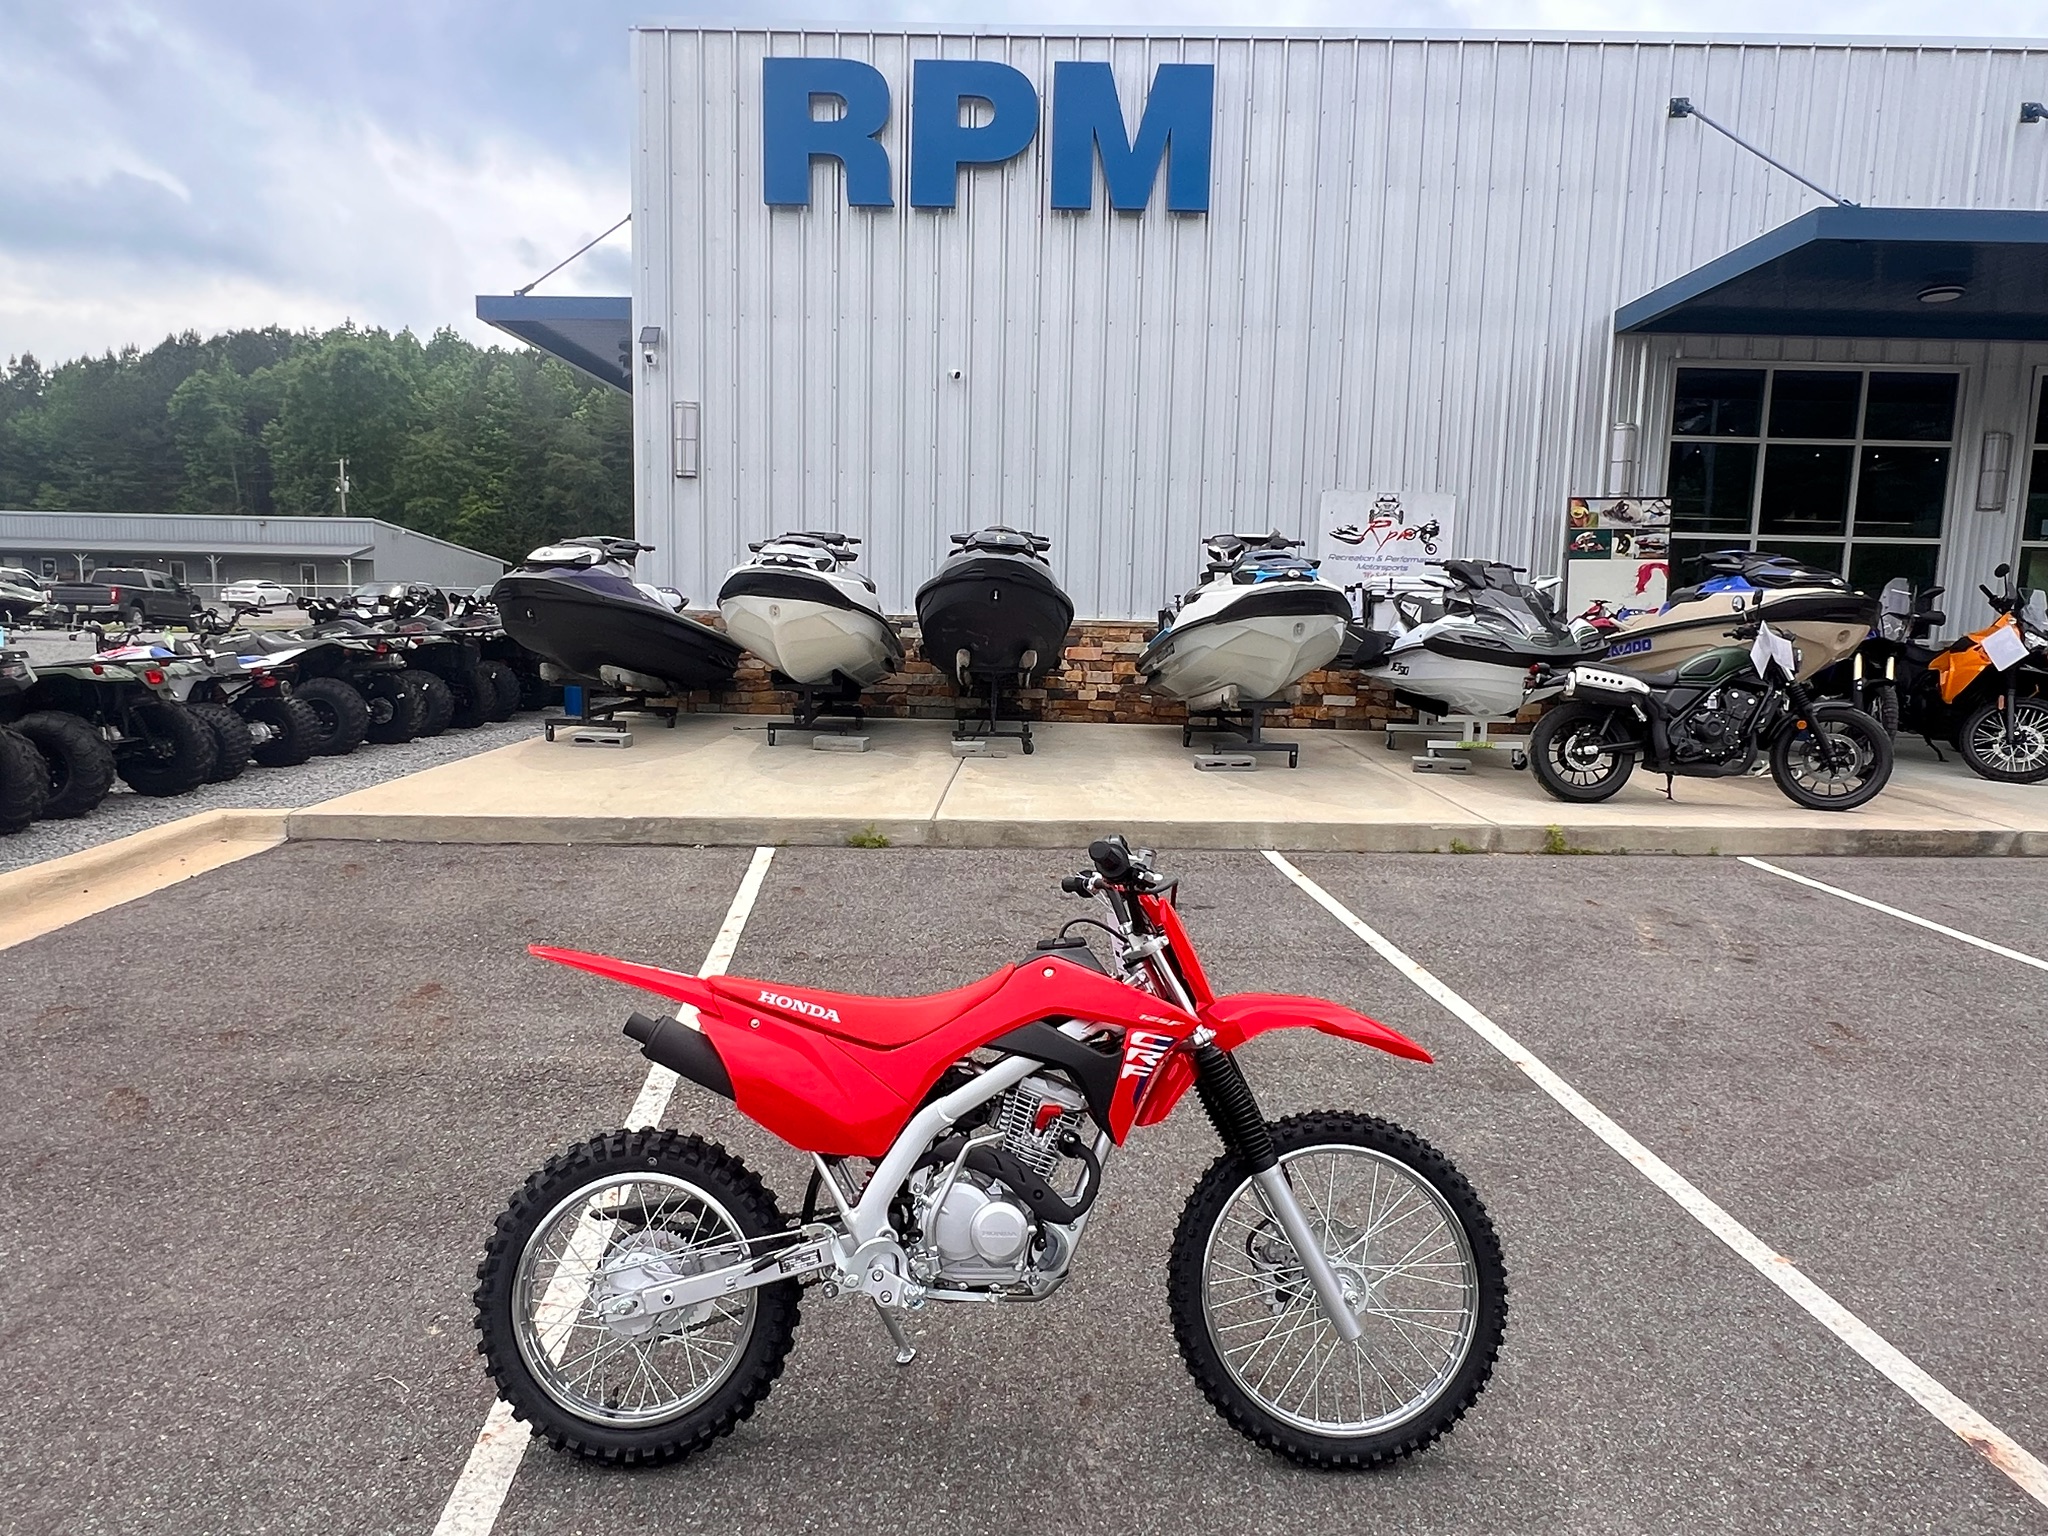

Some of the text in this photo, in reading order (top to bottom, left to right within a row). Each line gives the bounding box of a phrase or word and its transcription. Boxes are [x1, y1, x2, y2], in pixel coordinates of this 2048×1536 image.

[762, 57, 1215, 213] RPM
[1328, 553, 1375, 562] Recreation
[1384, 555, 1442, 563] Performance
[1356, 563, 1409, 572] Motorsports
[758, 990, 841, 1024] HONDA
